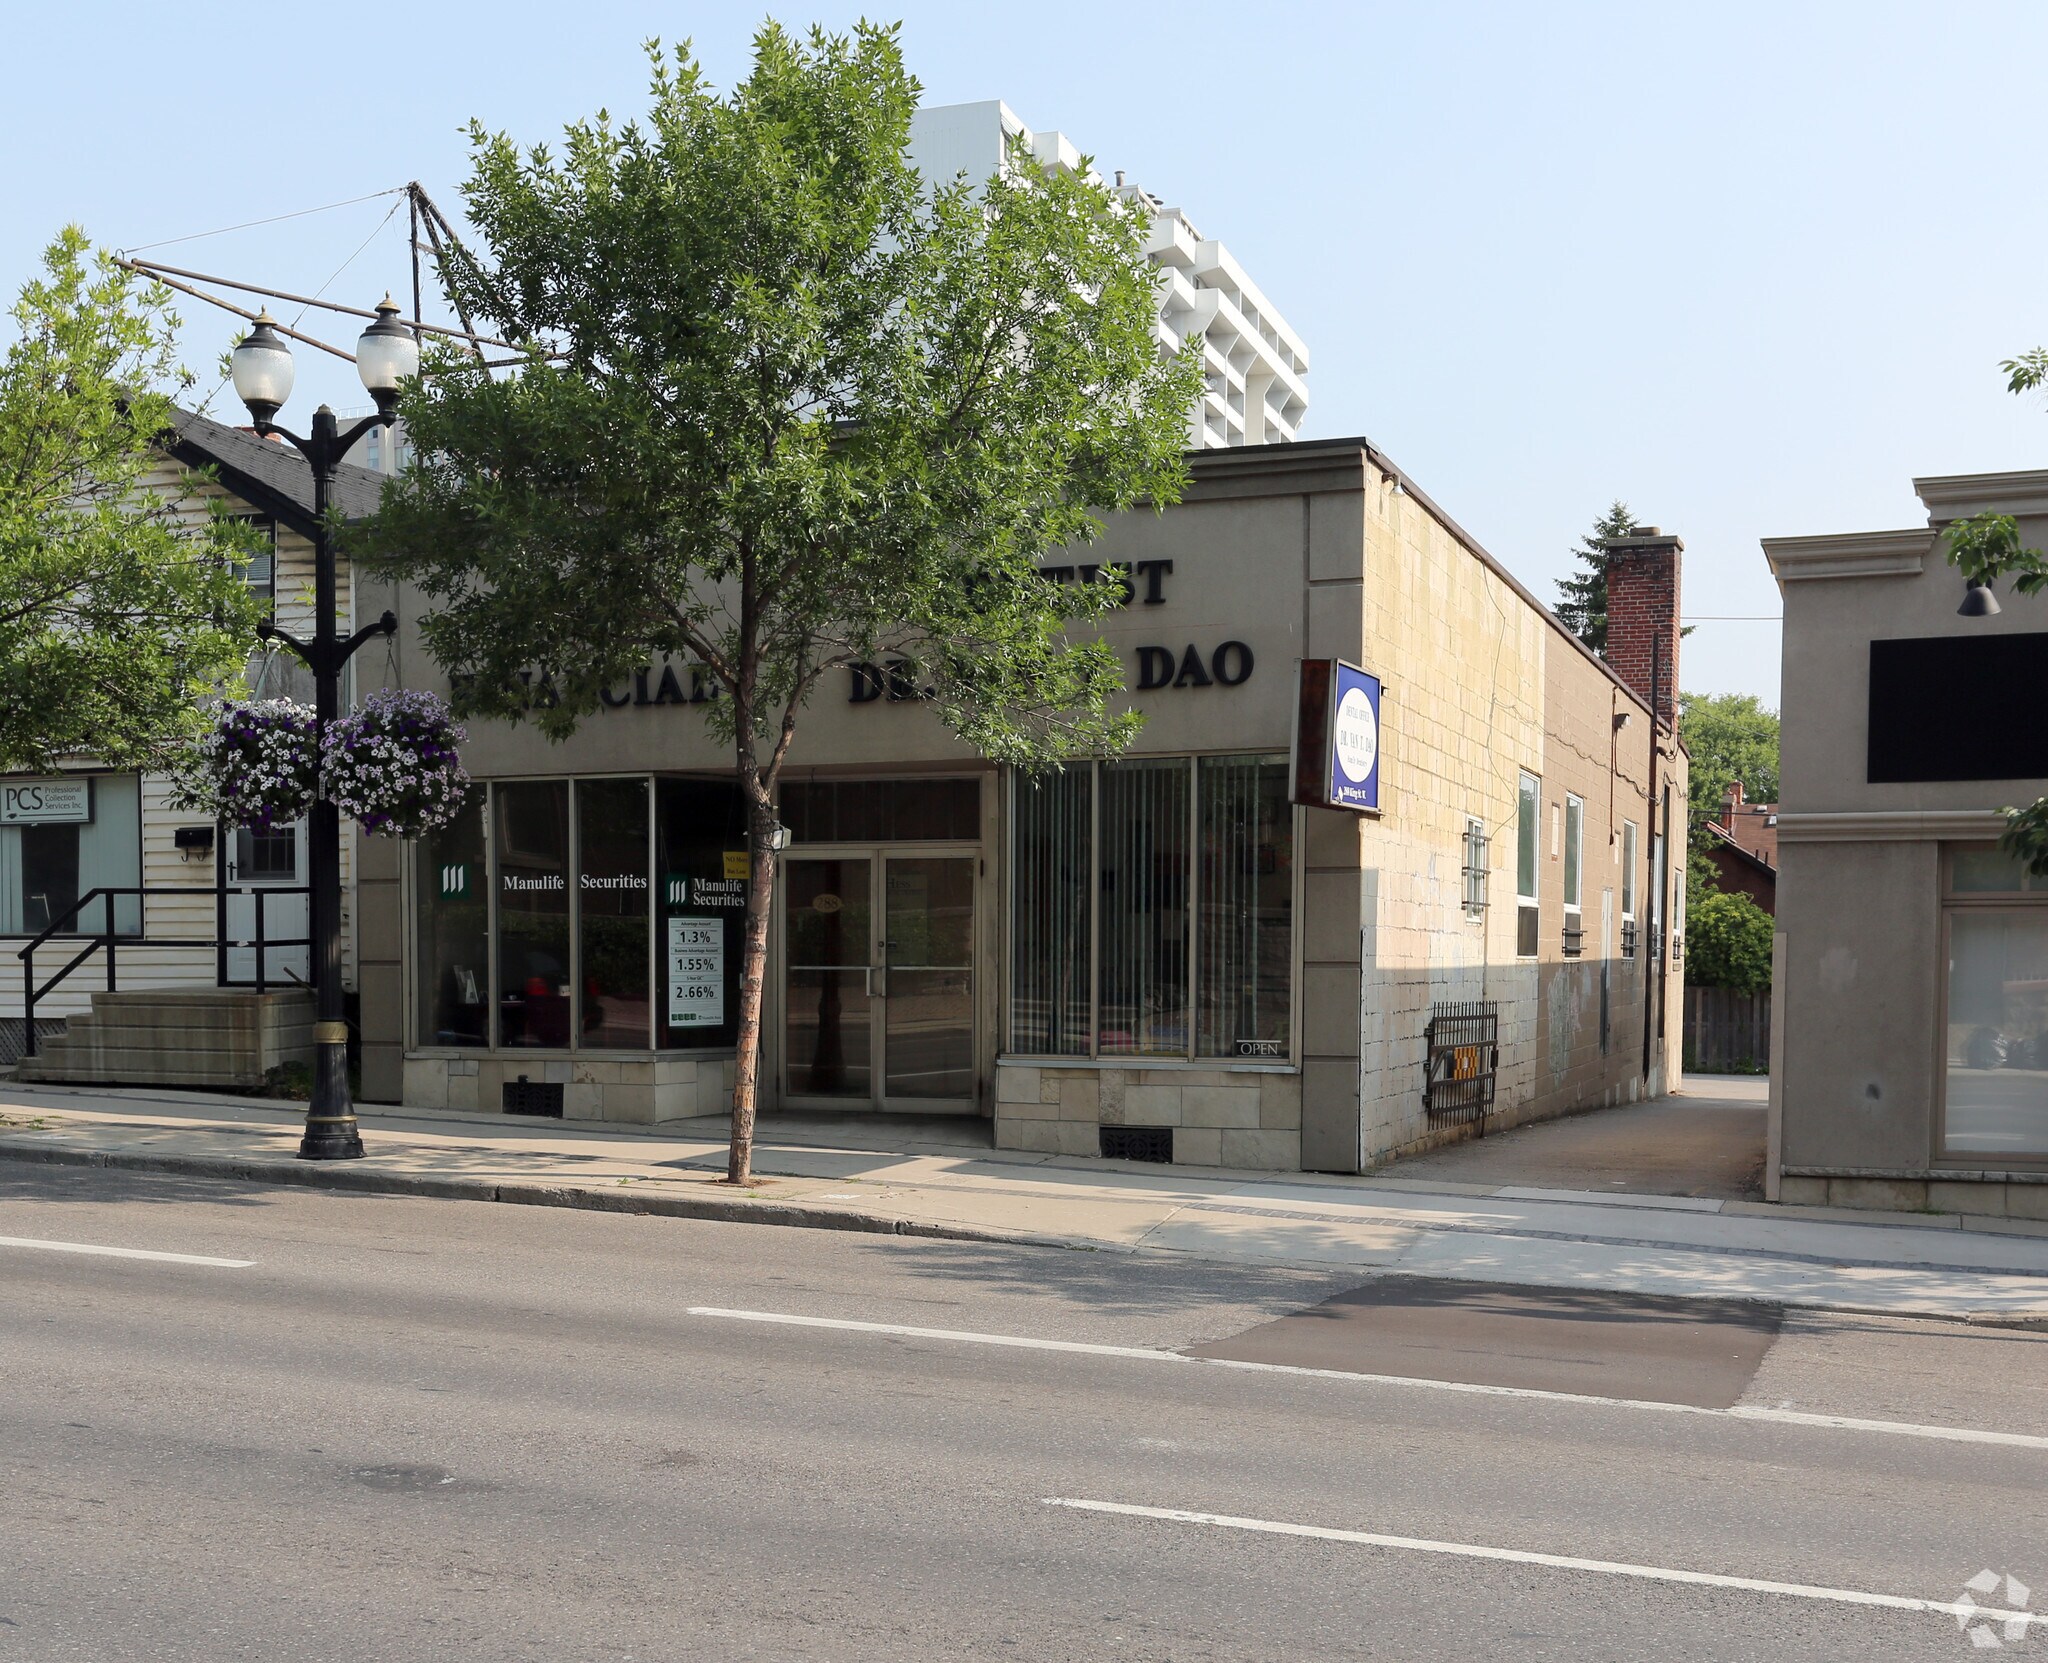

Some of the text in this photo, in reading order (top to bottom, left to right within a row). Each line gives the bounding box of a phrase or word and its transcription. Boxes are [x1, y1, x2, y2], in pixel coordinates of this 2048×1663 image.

[930, 559, 1173, 612] TIST
[1136, 640, 1255, 690] DAO
[448, 662, 719, 711] FACIAL
[6, 787, 43, 810] PCS
[504, 874, 647, 890] Manulife Securities
[694, 878, 742, 892] Manulife
[693, 892, 745, 907] Securities
[816, 897, 838, 909] 288
[680, 931, 711, 943] 1.3%
[677, 958, 714, 970] 1.55%
[676, 986, 714, 998] 2.66%
